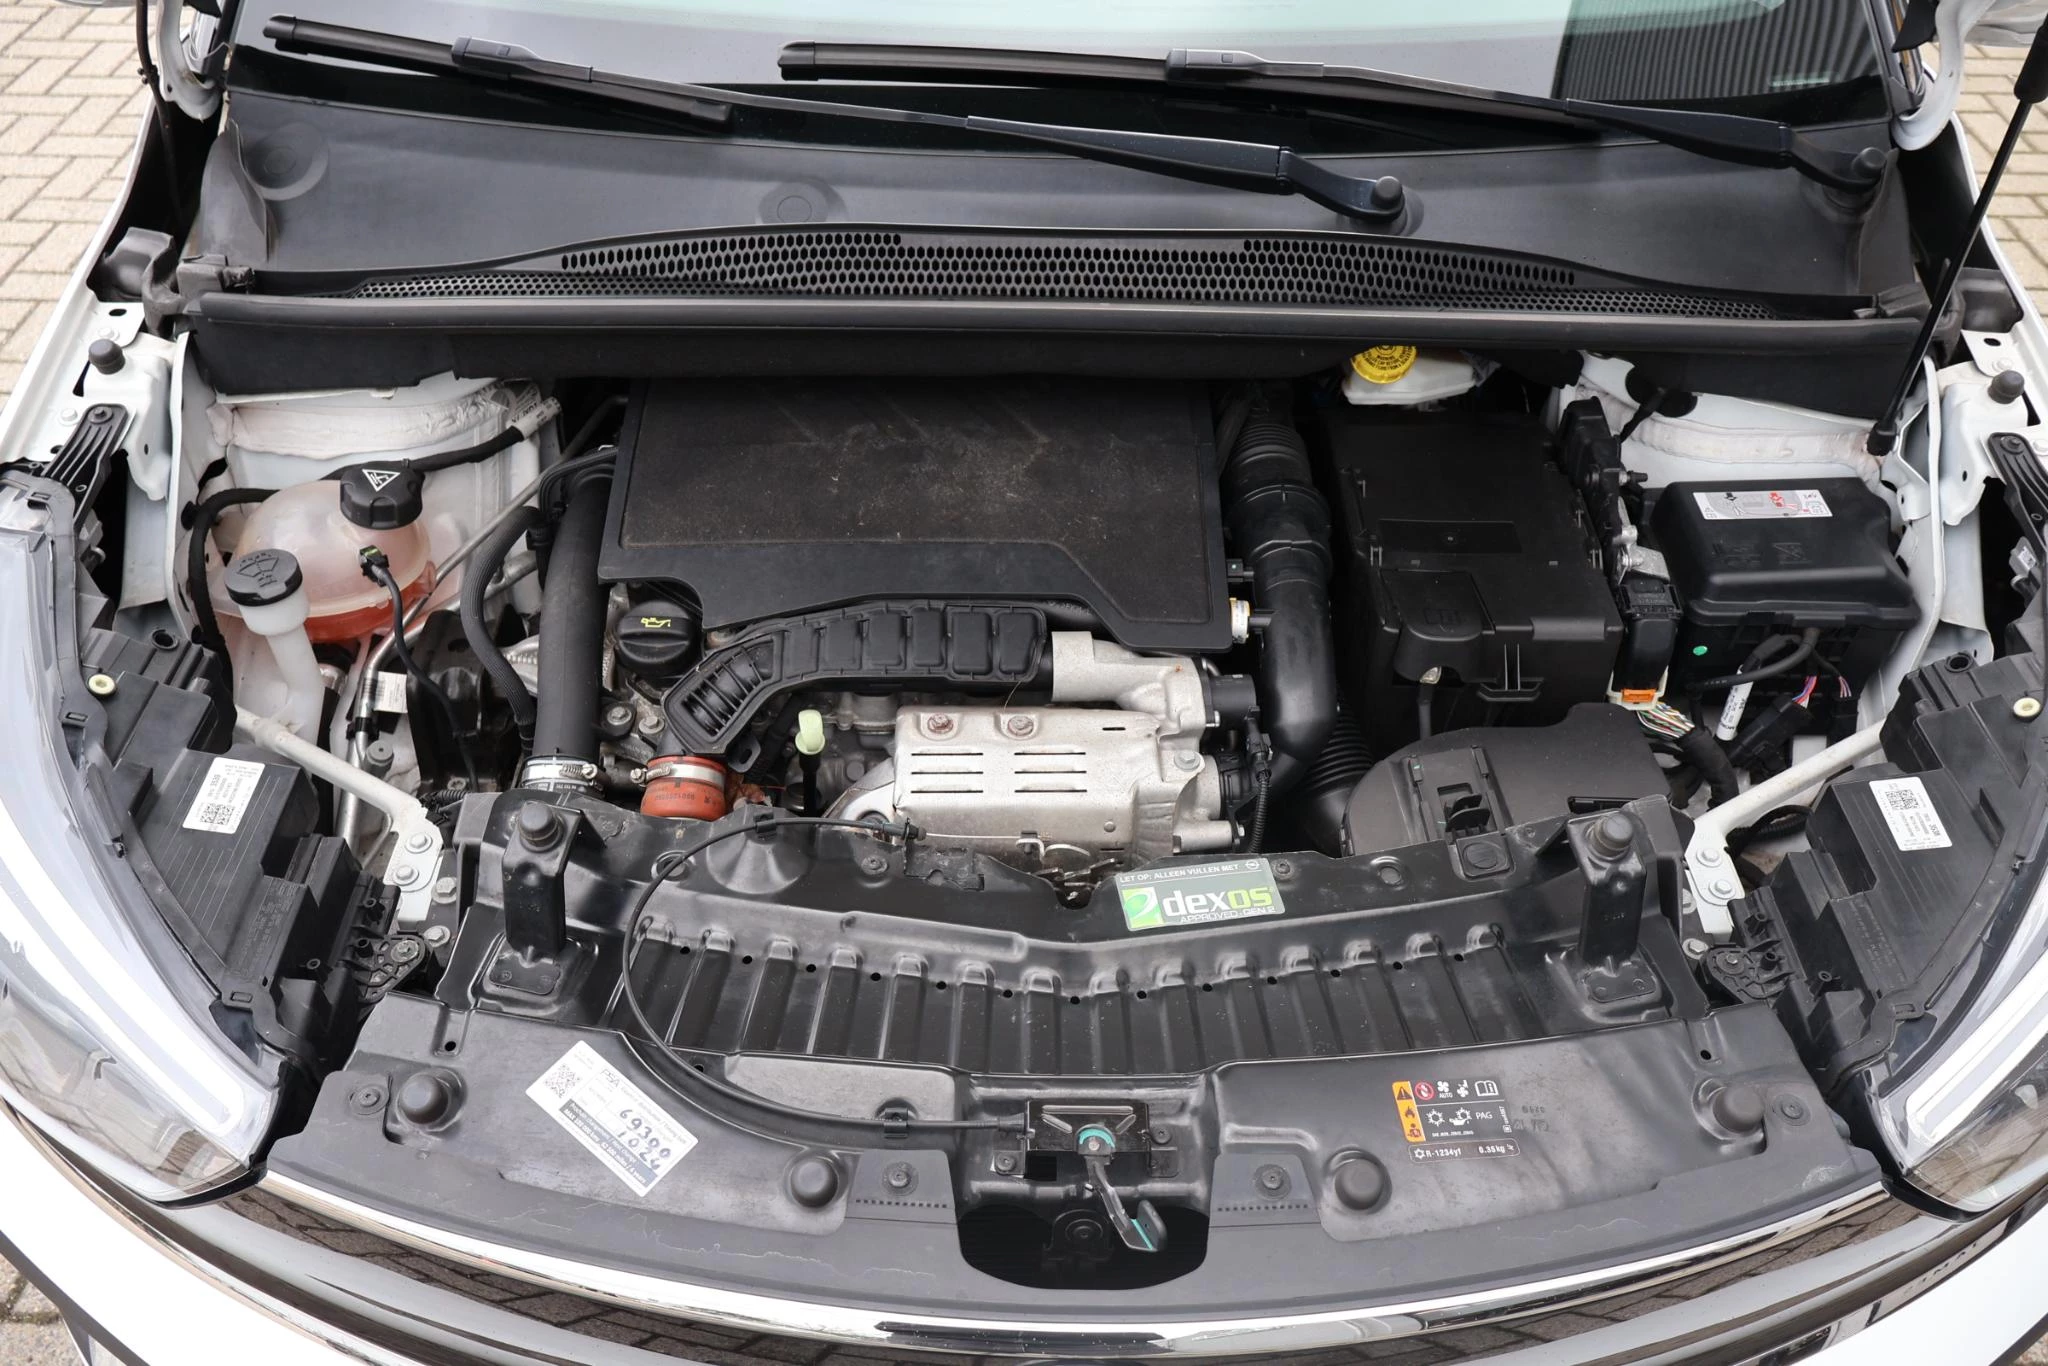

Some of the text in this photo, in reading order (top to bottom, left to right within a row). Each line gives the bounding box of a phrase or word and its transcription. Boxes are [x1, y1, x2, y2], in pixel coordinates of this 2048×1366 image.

[1154, 870, 1186, 880] ALLEEN
[1187, 866, 1220, 876] VULLEN
[1222, 864, 1239, 872] MET
[600, 1068, 621, 1088] PSA
[1476, 1111, 1493, 1120] PAG
[620, 1109, 671, 1159] 69300
[1426, 1147, 1462, 1158] R-1234yf
